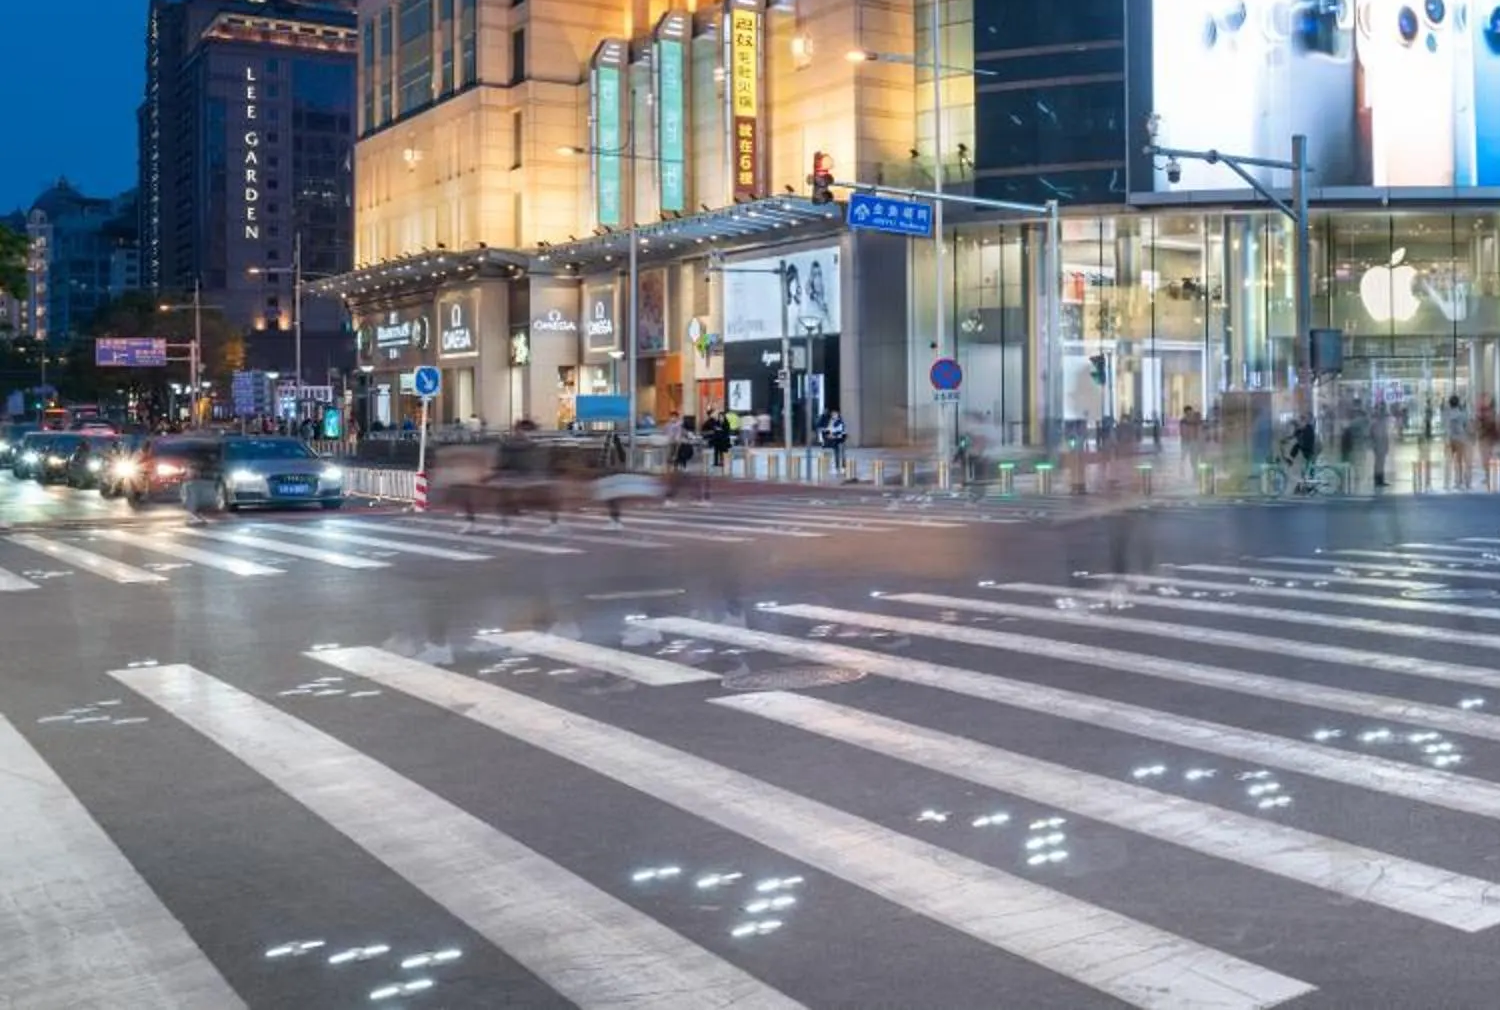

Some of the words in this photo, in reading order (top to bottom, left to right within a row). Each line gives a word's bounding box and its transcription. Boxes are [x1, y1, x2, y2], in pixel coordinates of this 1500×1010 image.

[247, 67, 256, 119] LEE
[245, 132, 258, 239] GARDEN
[534, 319, 577, 332] OMEGA
